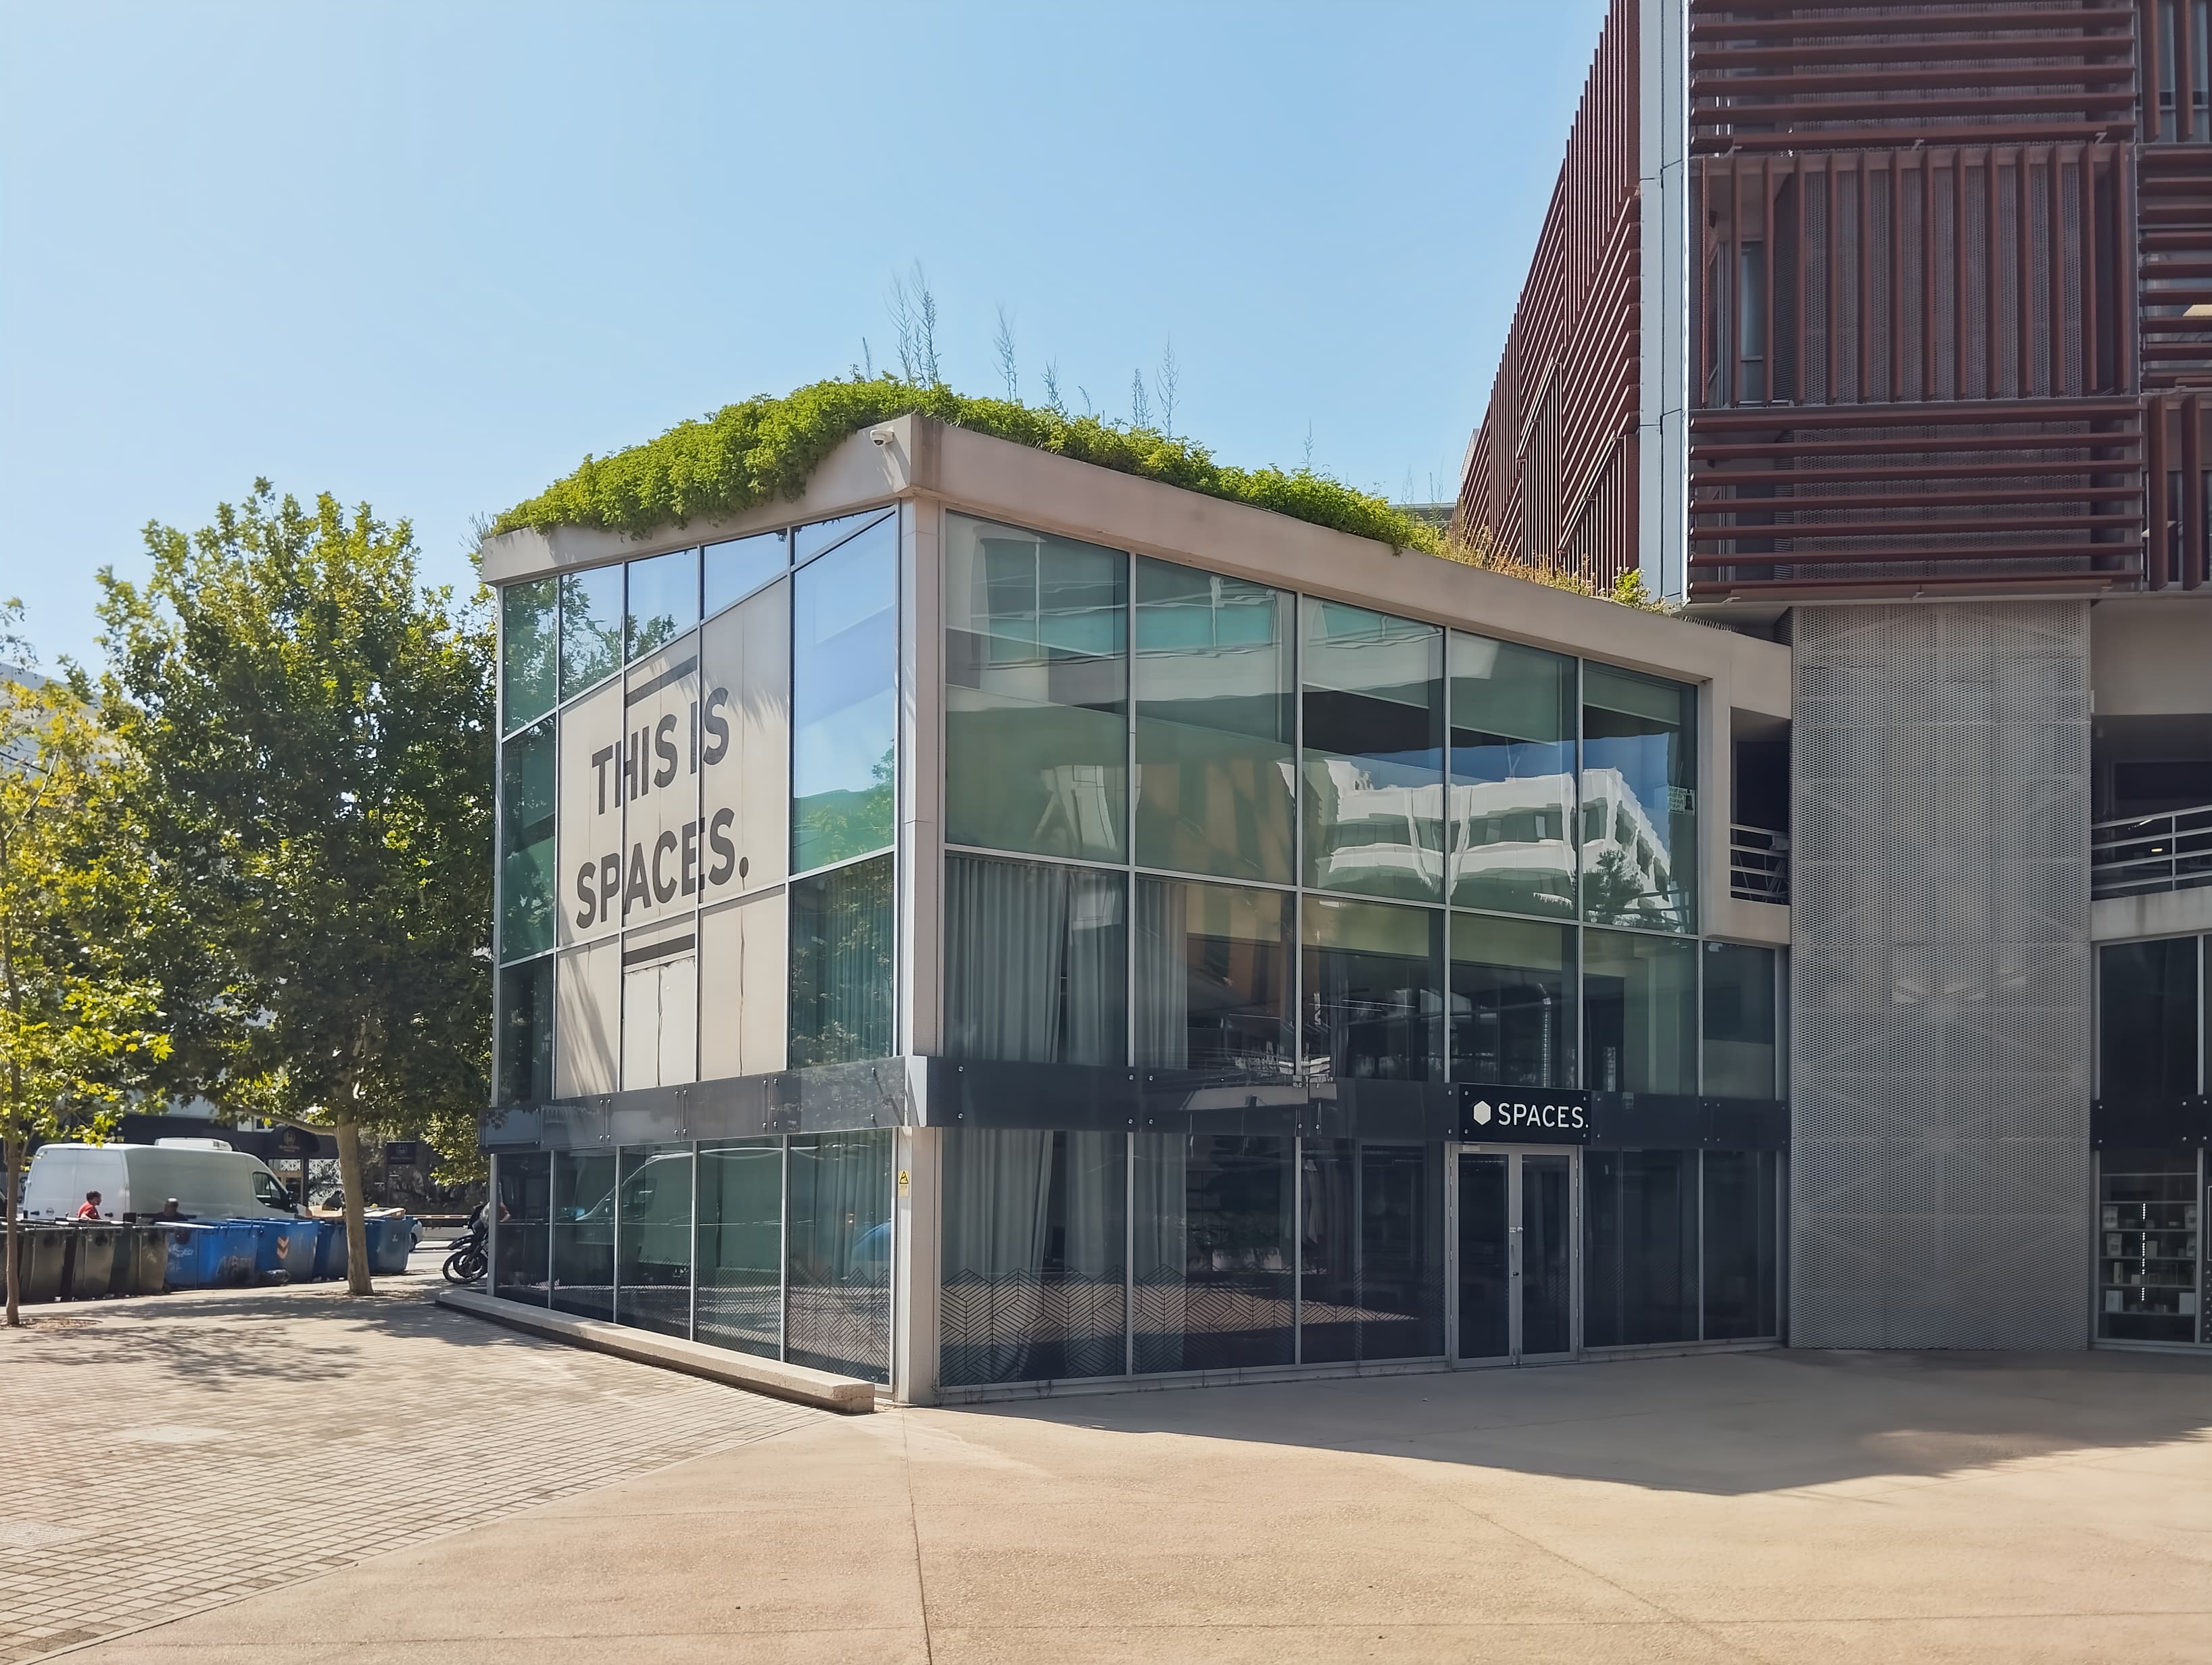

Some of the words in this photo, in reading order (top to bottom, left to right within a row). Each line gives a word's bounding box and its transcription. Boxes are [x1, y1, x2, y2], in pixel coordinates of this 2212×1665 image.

[592, 714, 677, 815] THIS
[690, 687, 729, 775] IS
[576, 807, 749, 930] SPACES.
[1498, 1103, 1589, 1129] SPACES.
